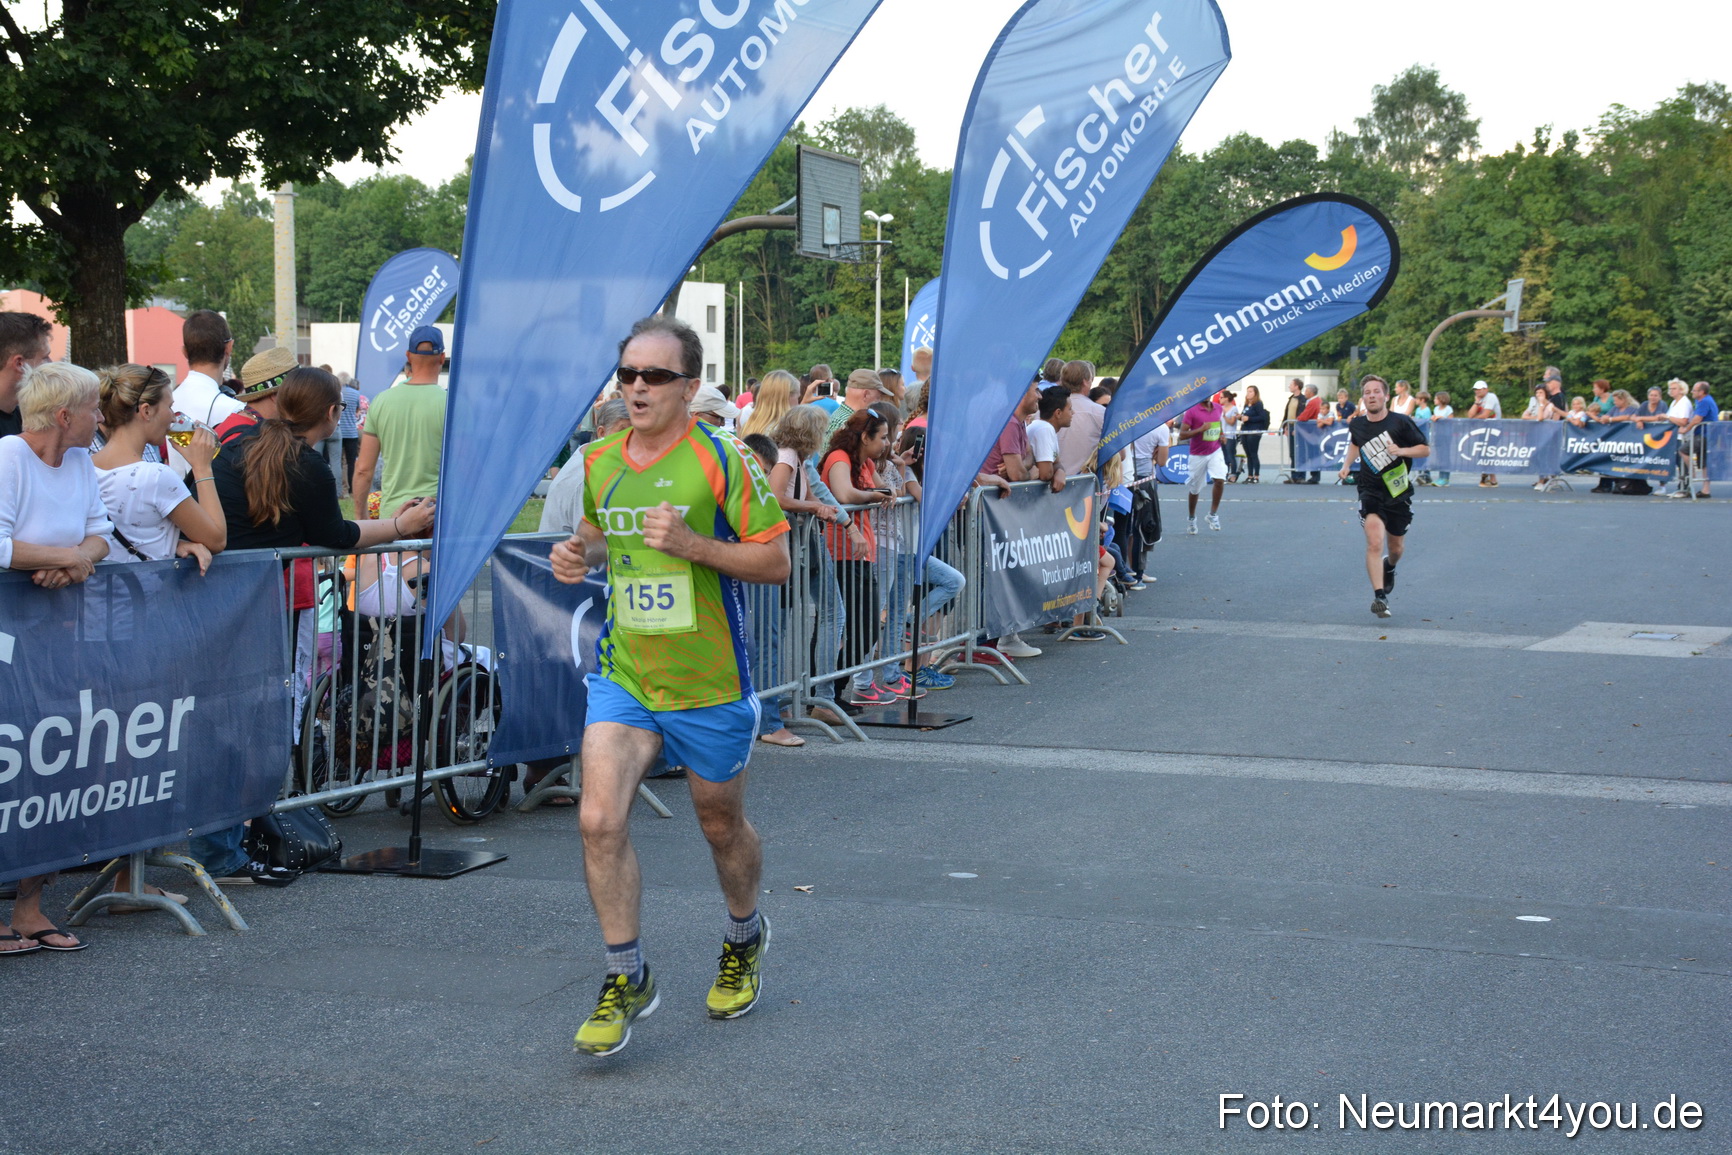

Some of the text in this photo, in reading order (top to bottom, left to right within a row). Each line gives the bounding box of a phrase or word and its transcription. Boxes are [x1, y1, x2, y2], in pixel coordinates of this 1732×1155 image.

[1015, 11, 1169, 241] Fischer
[1069, 55, 1187, 238] AUTOMOBILE
[383, 265, 441, 340] Fischer
[404, 279, 448, 339] AUTOMOBILE
[1150, 274, 1323, 376] Frischmann
[1261, 263, 1382, 334] Druck und Medien
[1097, 375, 1208, 450] www.frischmann-net.de
[1471, 441, 1537, 458] Fischer
[1476, 458, 1530, 467] AUTOMOBILE
[990, 527, 1073, 572] Frischmann
[1042, 565, 1062, 586] Druck
[1062, 563, 1075, 581] und
[625, 583, 675, 611] 155
